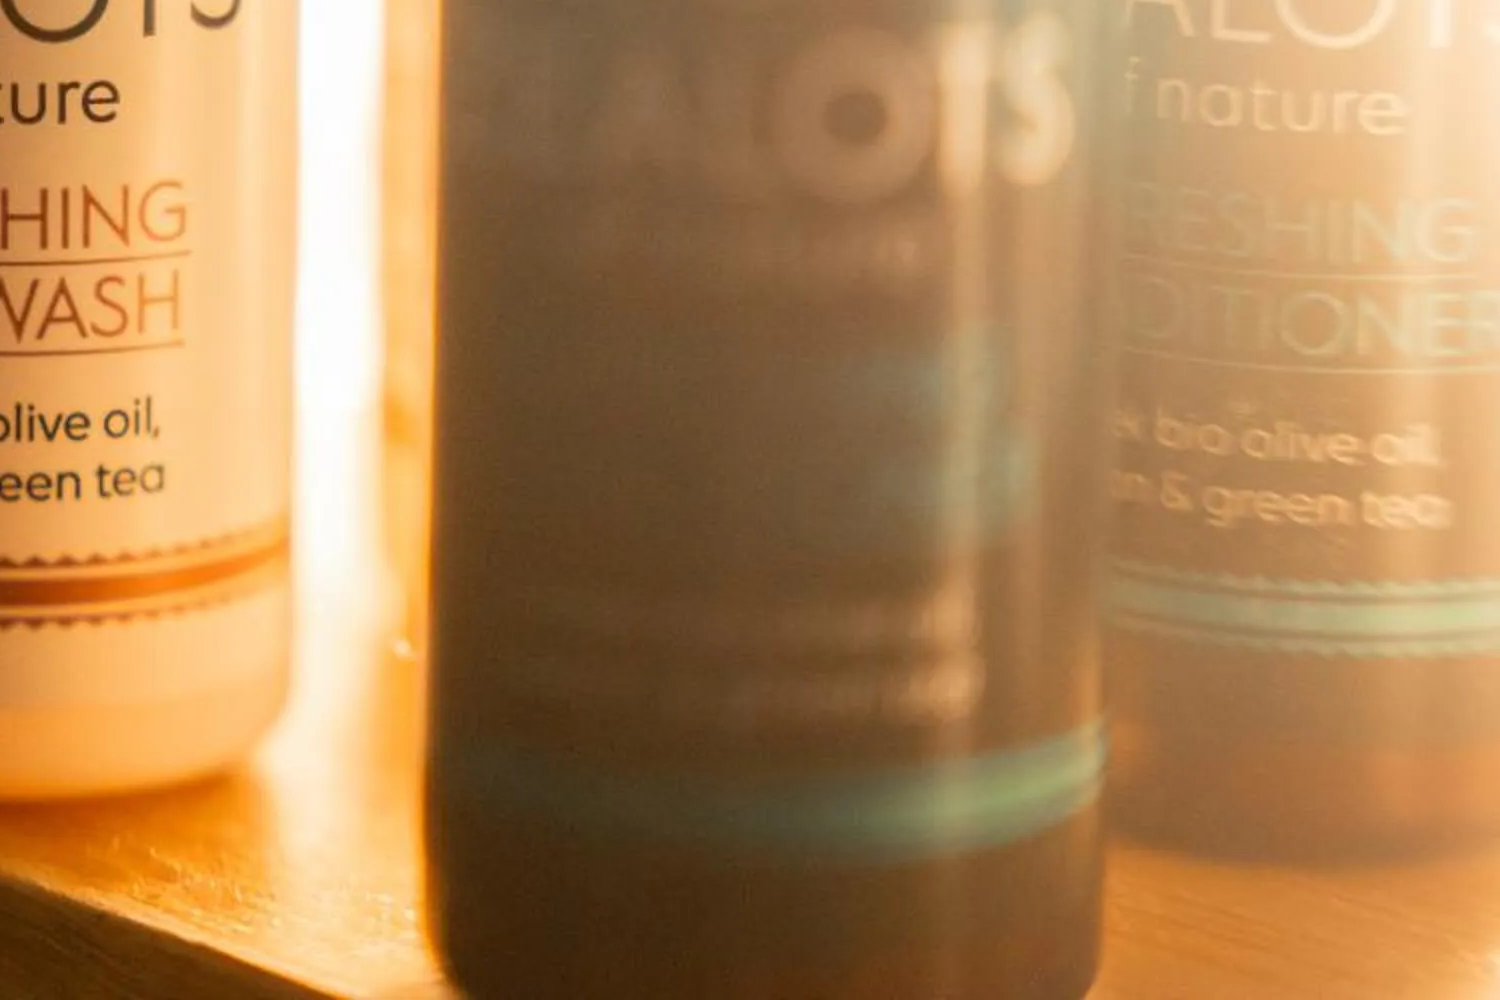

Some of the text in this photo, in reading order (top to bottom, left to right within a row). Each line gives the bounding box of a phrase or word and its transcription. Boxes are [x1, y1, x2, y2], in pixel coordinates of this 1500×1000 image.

[1155, 74, 1410, 137] nature
[103, 396, 161, 439] oil,
[94, 460, 167, 499] tea
[1200, 483, 1356, 530] green
